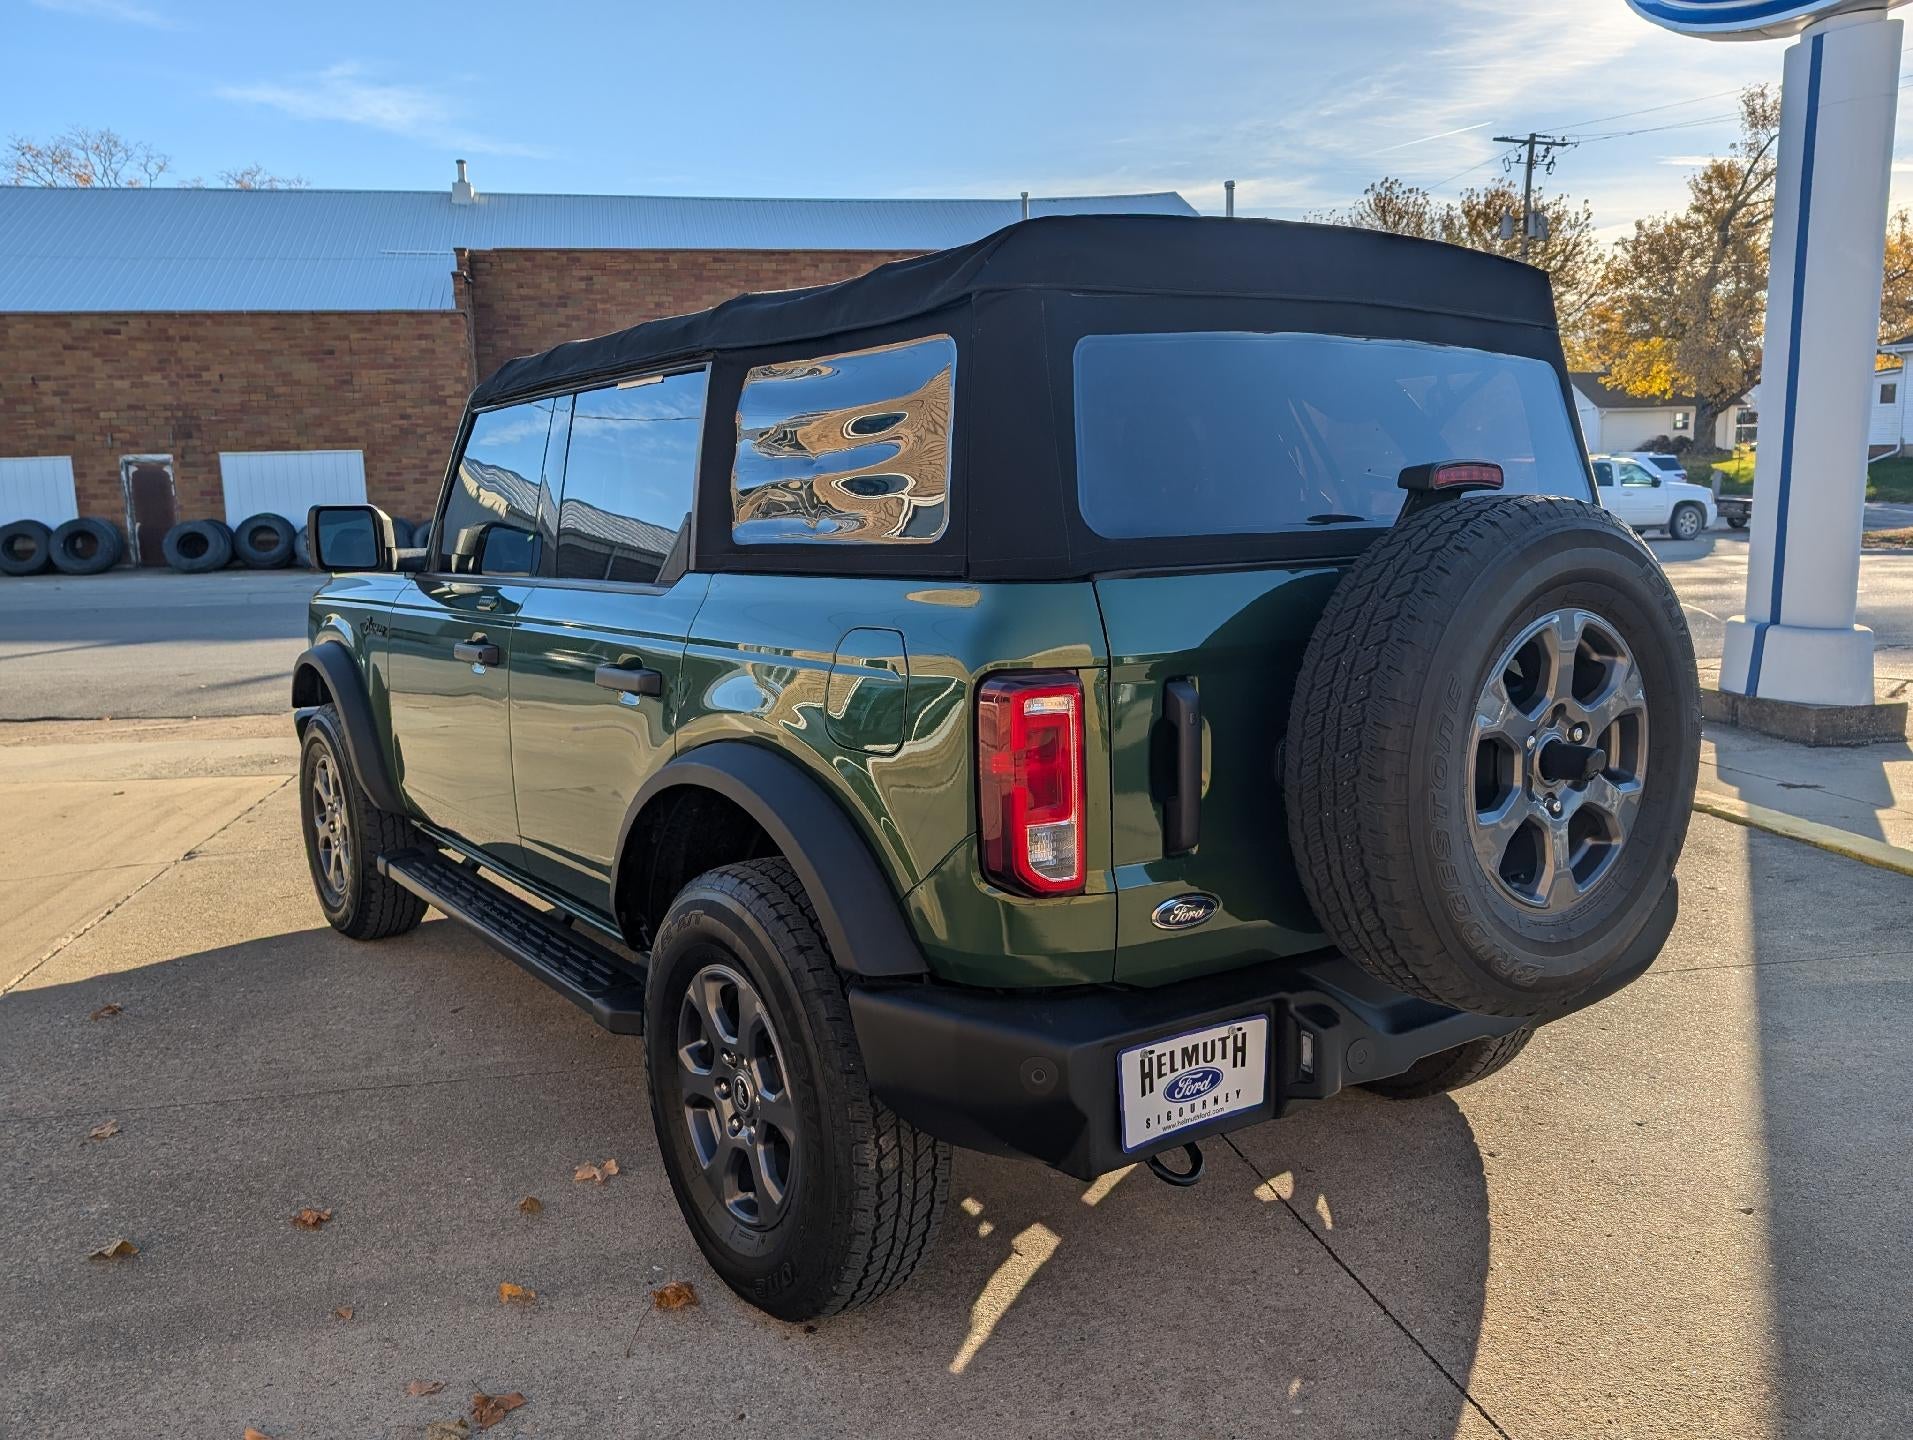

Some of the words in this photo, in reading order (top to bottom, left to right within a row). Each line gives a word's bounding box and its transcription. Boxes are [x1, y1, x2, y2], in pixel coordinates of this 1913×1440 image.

[1169, 903, 1206, 924] Ford
[1139, 1031, 1248, 1098] HELMUTH
[1174, 1072, 1213, 1099] Ford
[1145, 1088, 1242, 1130] SIGOURNEY
